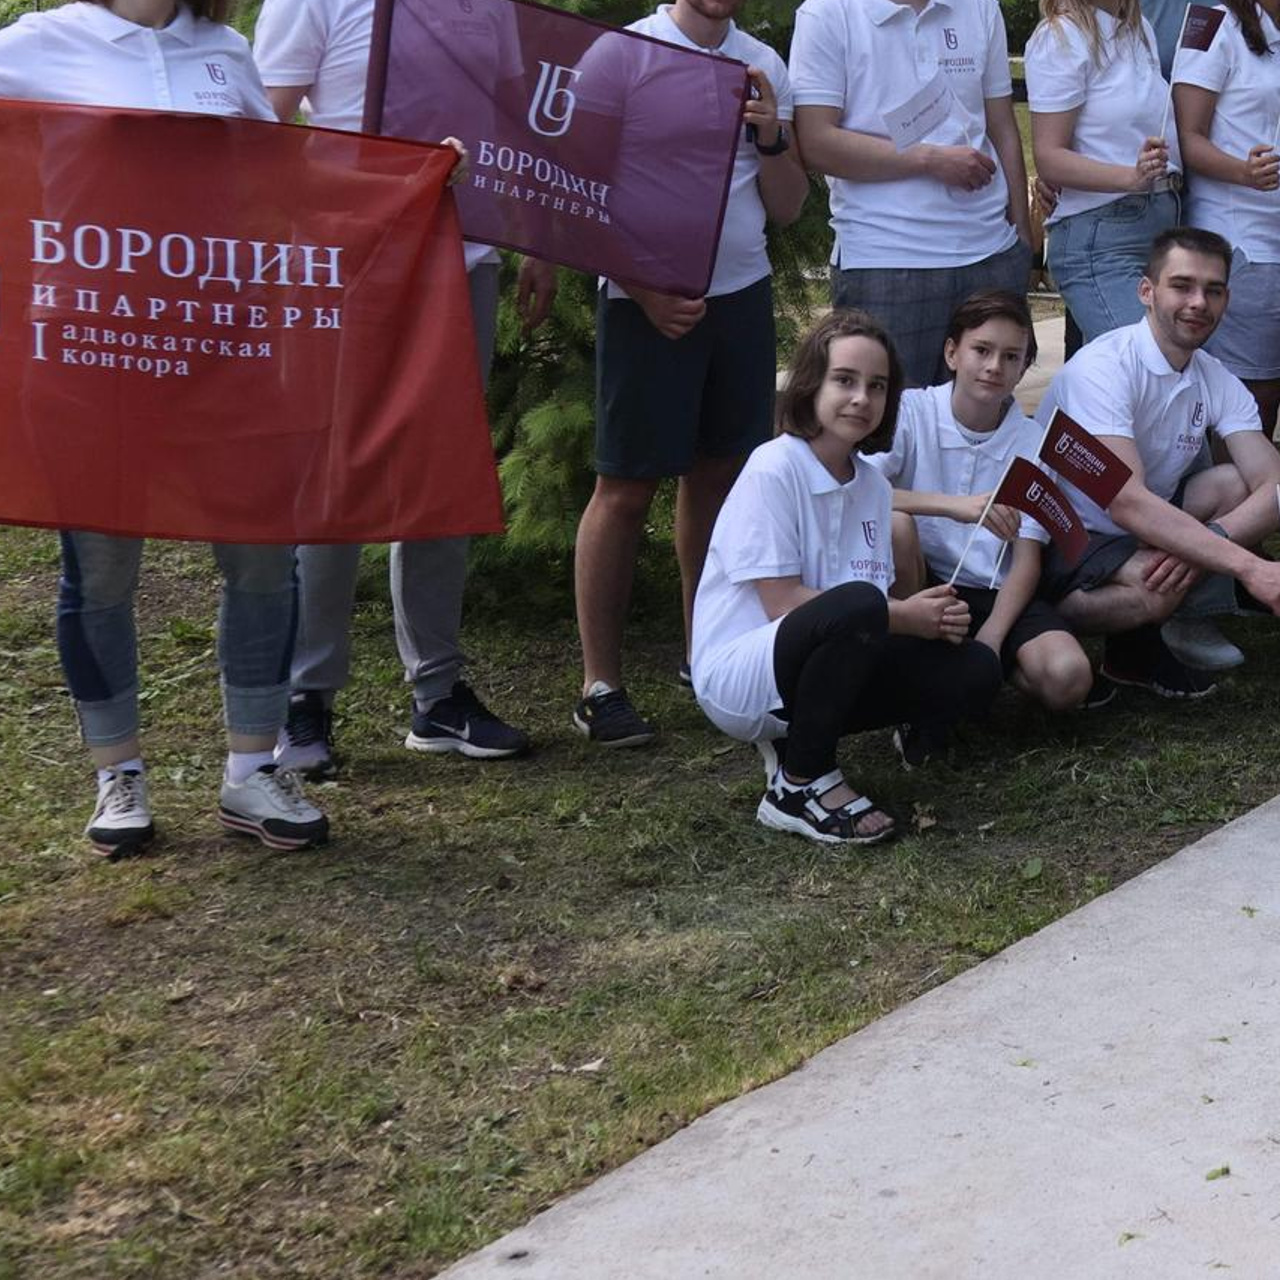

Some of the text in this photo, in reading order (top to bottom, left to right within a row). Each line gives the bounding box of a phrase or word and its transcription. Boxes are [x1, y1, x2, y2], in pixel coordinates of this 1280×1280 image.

[477, 140, 612, 208] БОРОДИН
[31, 219, 344, 293] БОРОДИН
[62, 323, 272, 358] адвокатская
[62, 347, 189, 378] контора
